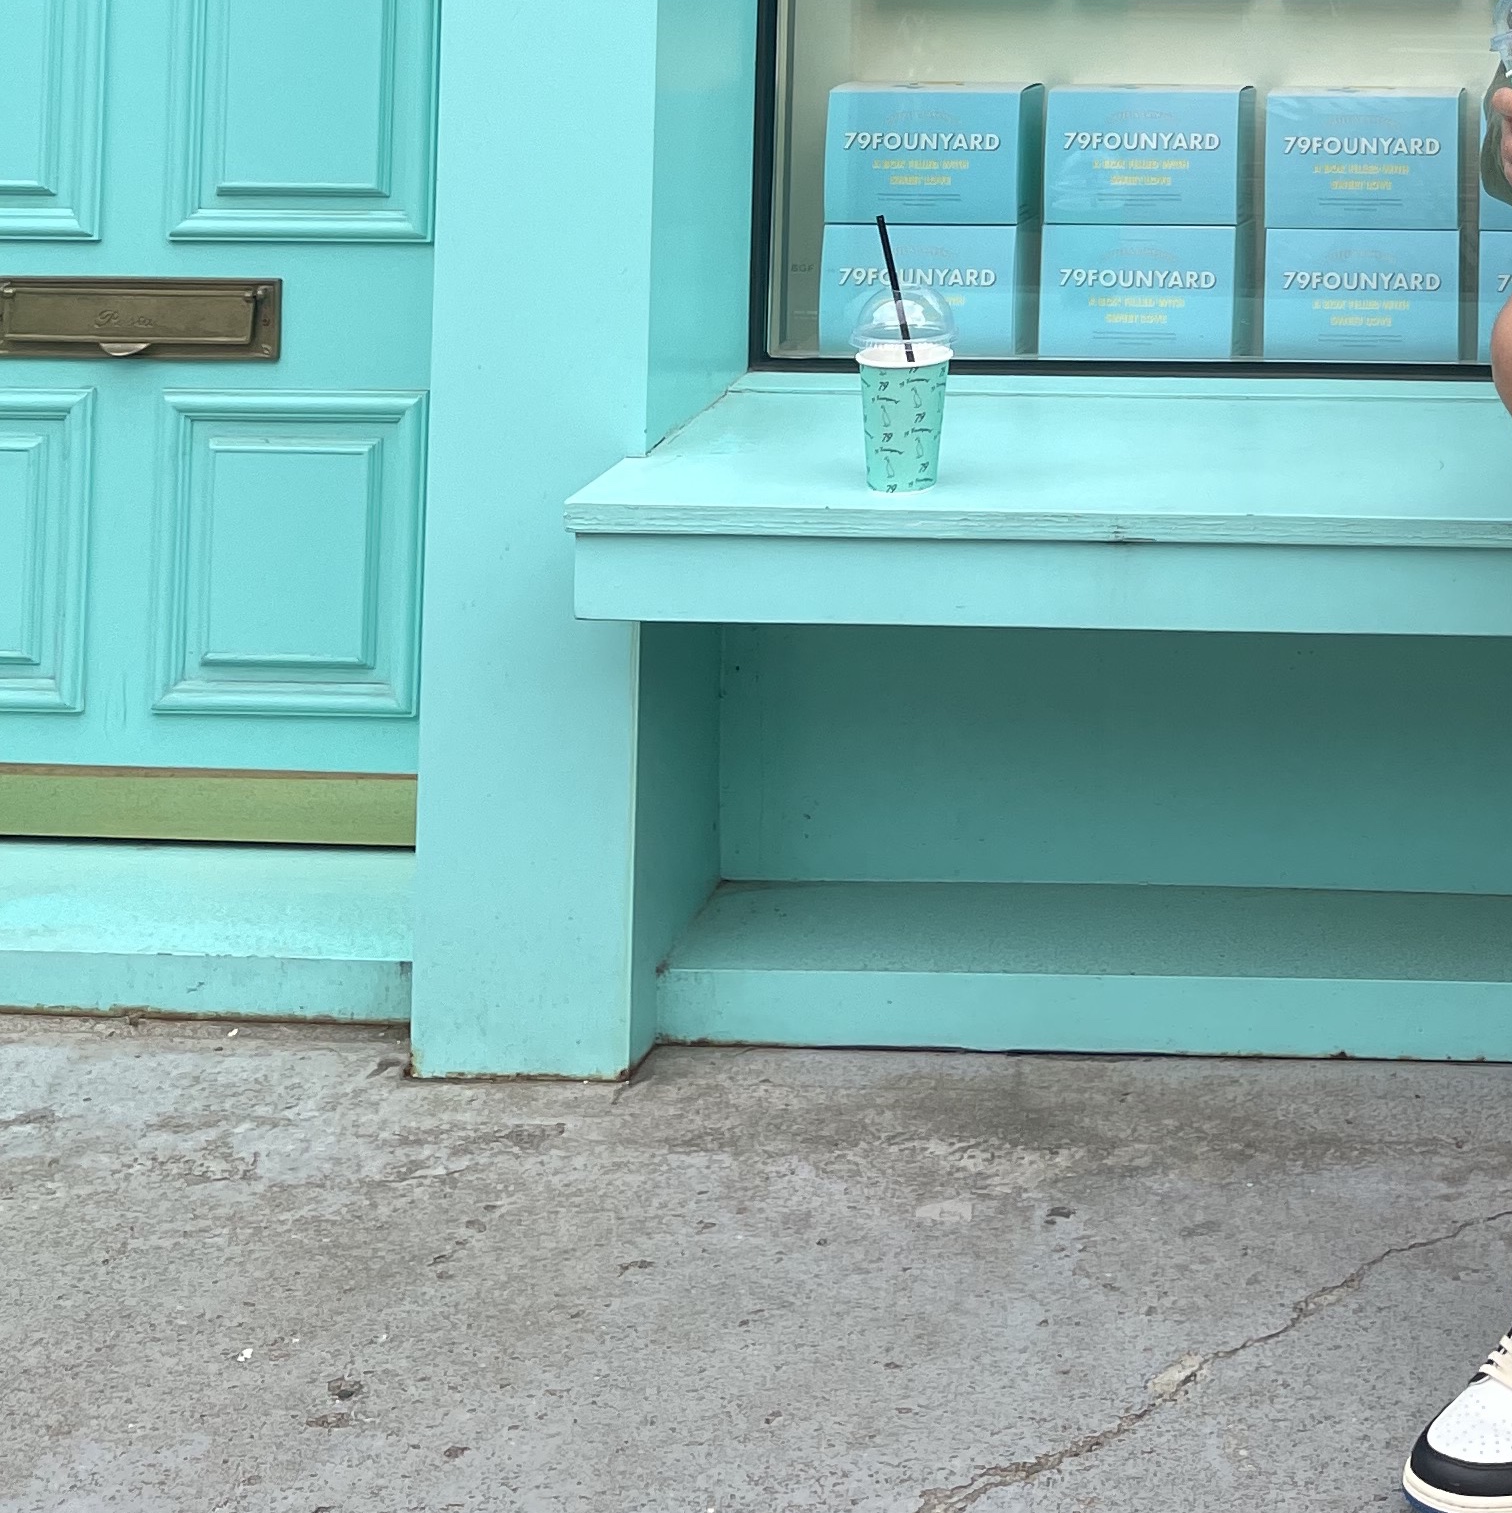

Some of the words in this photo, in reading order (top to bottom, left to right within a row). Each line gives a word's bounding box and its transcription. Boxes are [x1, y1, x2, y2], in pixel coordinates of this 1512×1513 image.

[844, 131, 1000, 151] 79FOUNYARD
[1063, 131, 1221, 151] 79FOUNYARD
[1283, 136, 1441, 157] 79FOUNYARD
[1059, 268, 1217, 289] 79FOUNYARD
[1282, 271, 1441, 292] 79FOUNYARD
